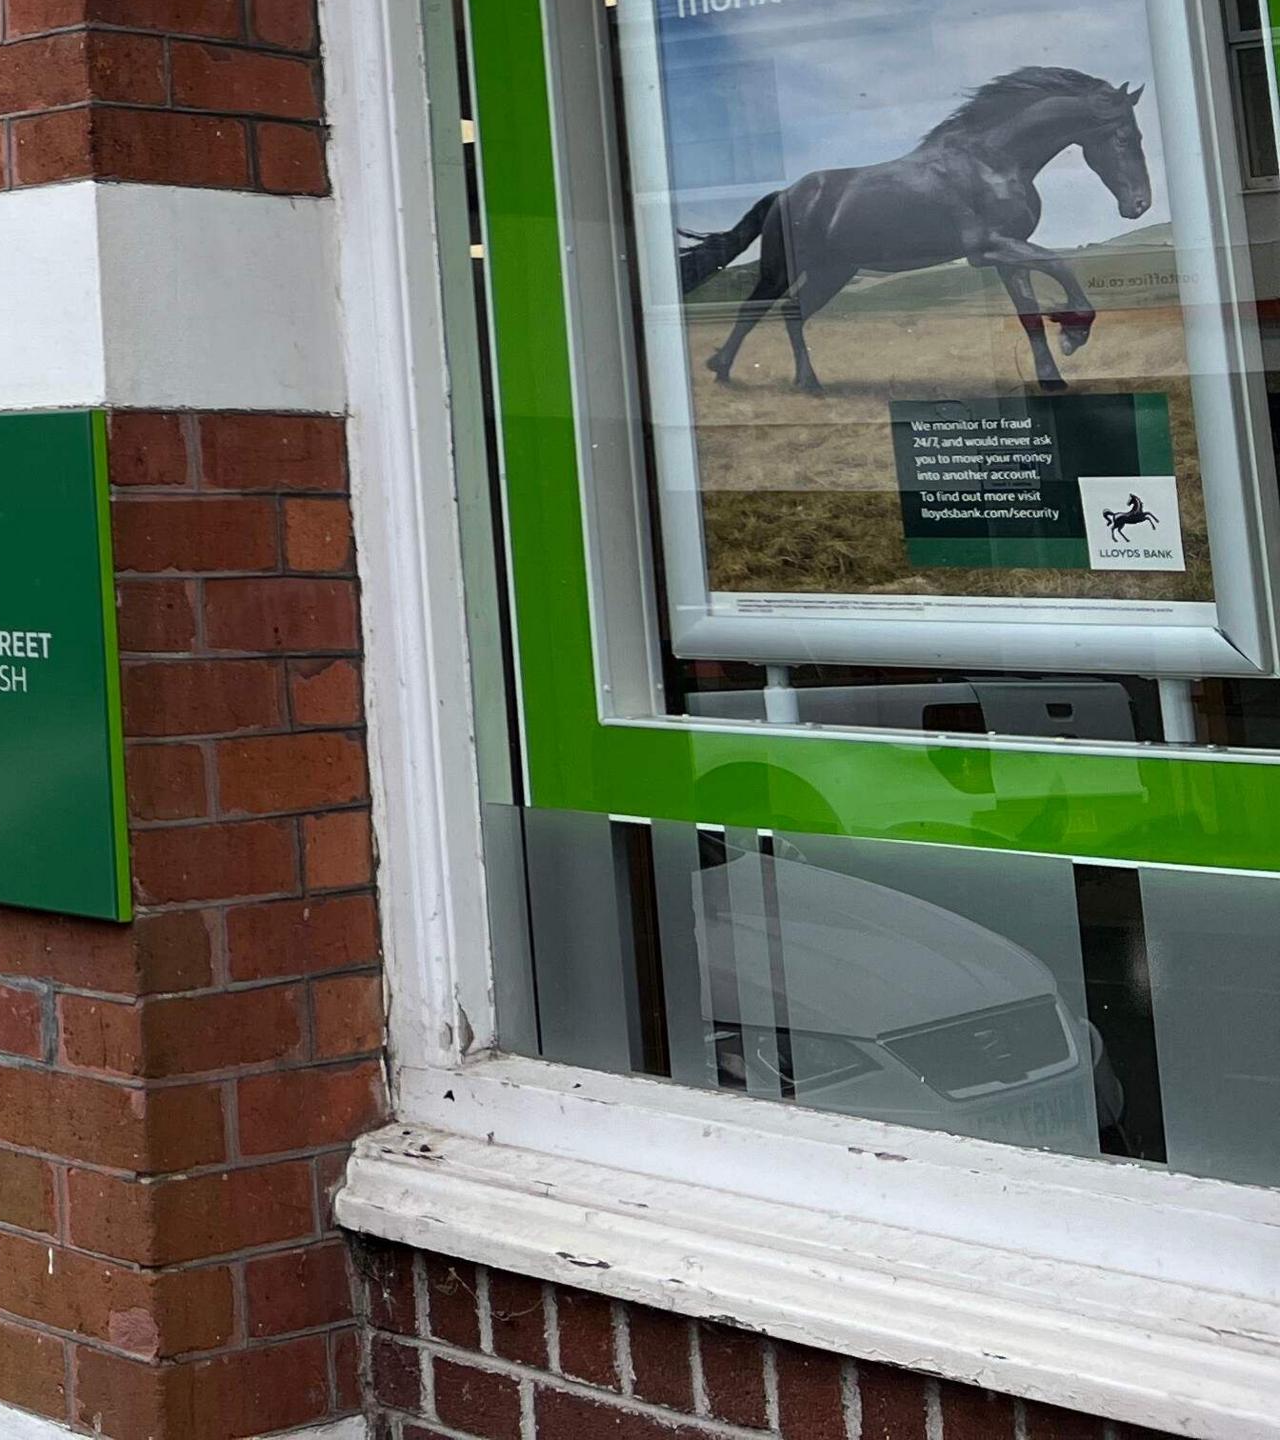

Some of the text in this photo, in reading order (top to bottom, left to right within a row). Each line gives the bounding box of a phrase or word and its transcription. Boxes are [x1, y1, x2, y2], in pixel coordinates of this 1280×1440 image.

[911, 418, 1032, 431] We monitor for fraud
[941, 436, 963, 446] and
[964, 436, 998, 446] would
[1000, 437, 1030, 445] never
[1033, 434, 1052, 445] ask
[915, 453, 1052, 466] you to move your money
[917, 470, 1040, 480] into another account.
[920, 491, 1041, 502] To find out more visit
[922, 508, 1059, 521] lloydsbank.com/security
[1100, 549, 1173, 558] LLOYDS BANK
